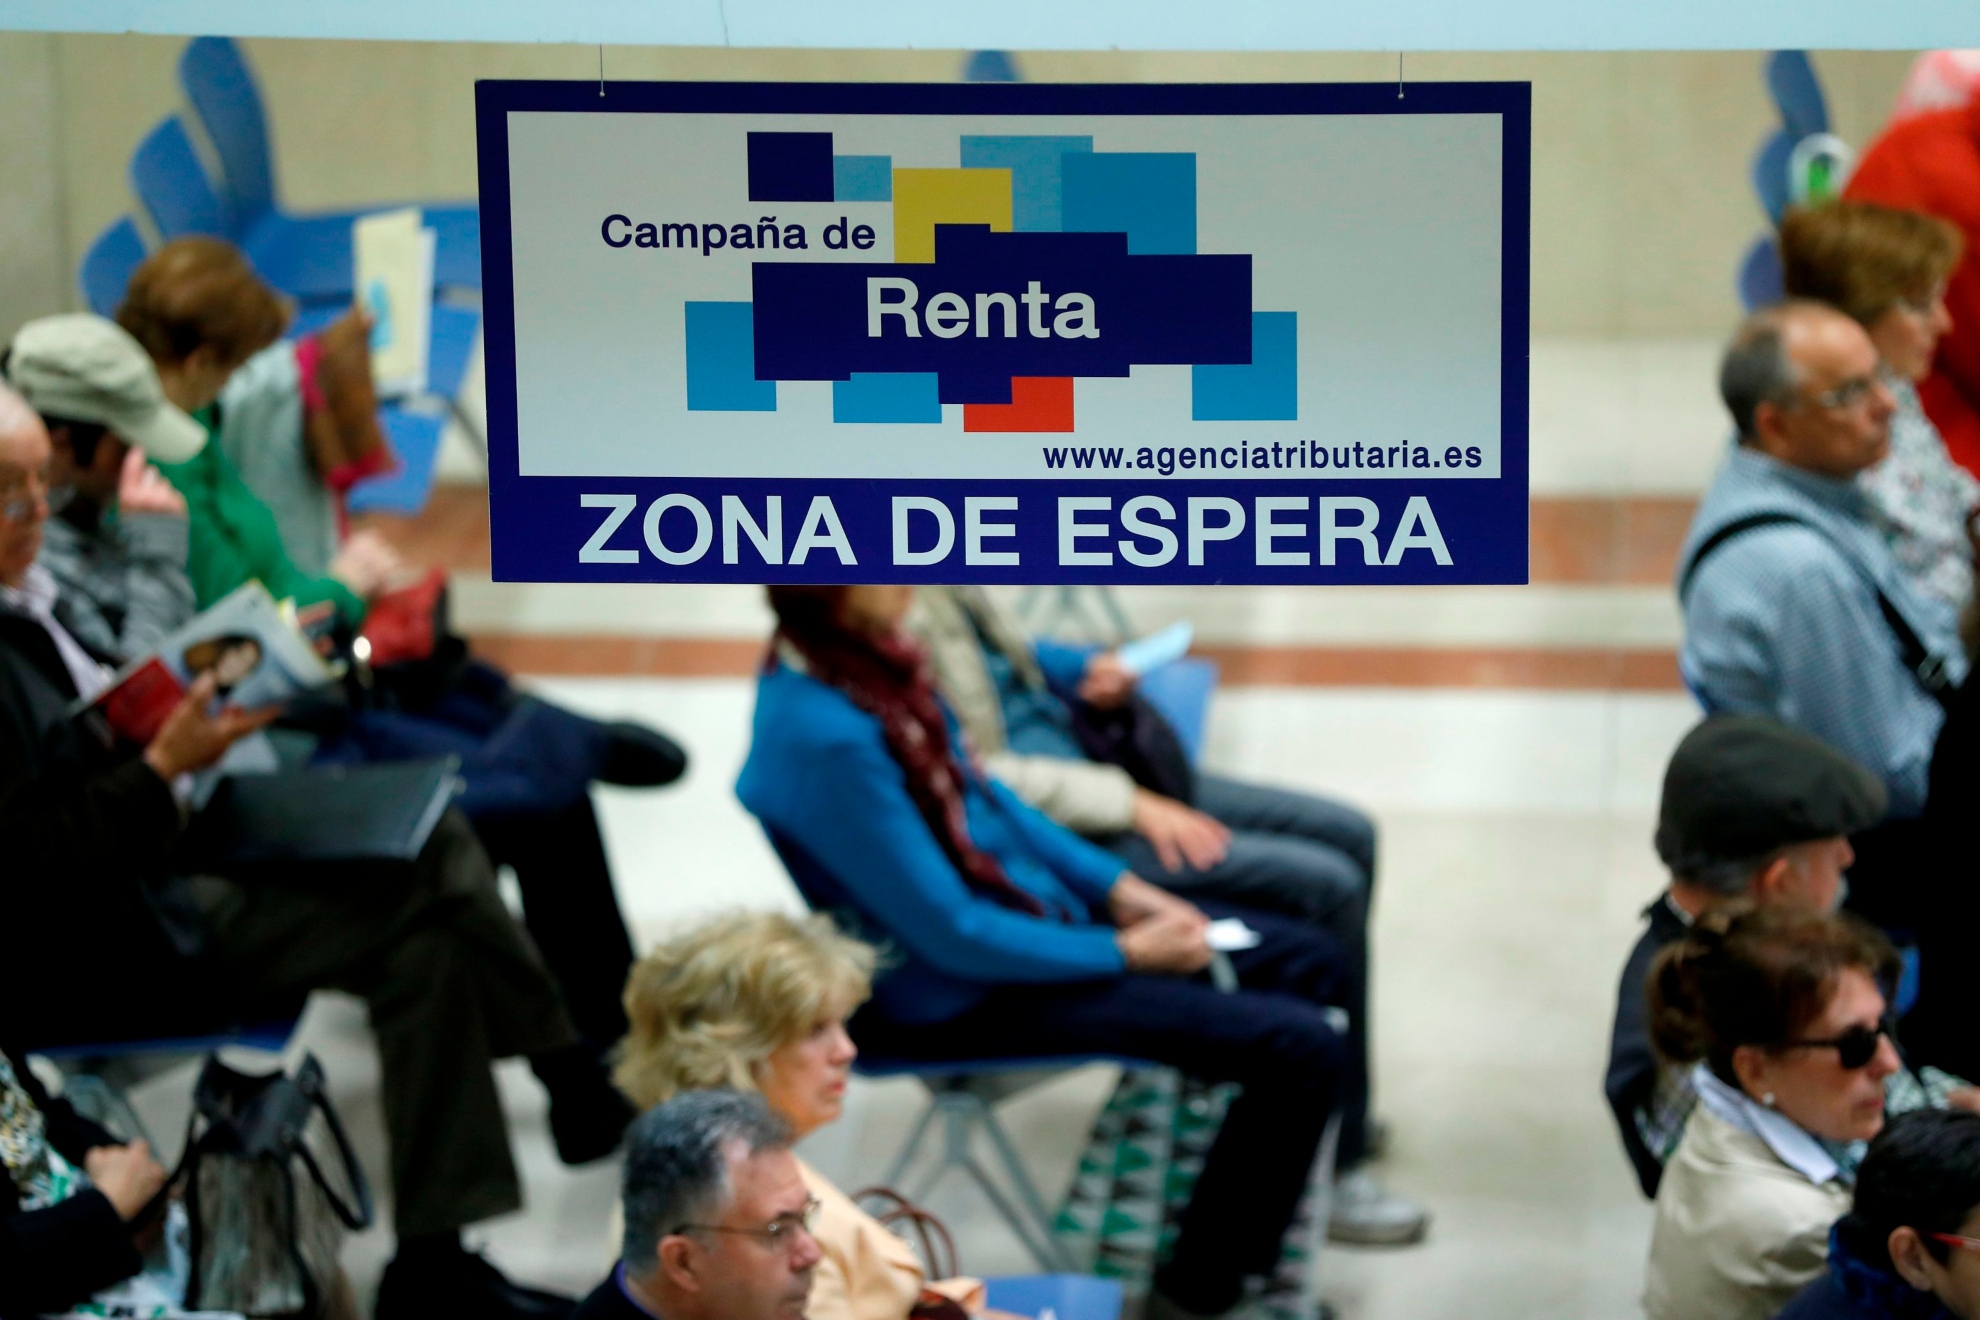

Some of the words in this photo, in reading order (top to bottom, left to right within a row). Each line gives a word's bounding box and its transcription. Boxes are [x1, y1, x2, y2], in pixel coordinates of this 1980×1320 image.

[601, 213, 809, 257] Campaña
[822, 216, 876, 250] de
[866, 276, 1100, 339] Renta
[1043, 440, 1482, 475] www.agenciatributaria.es
[578, 493, 859, 566] ZONA
[891, 496, 1020, 566] DE
[1057, 495, 1454, 568] ESPERA
